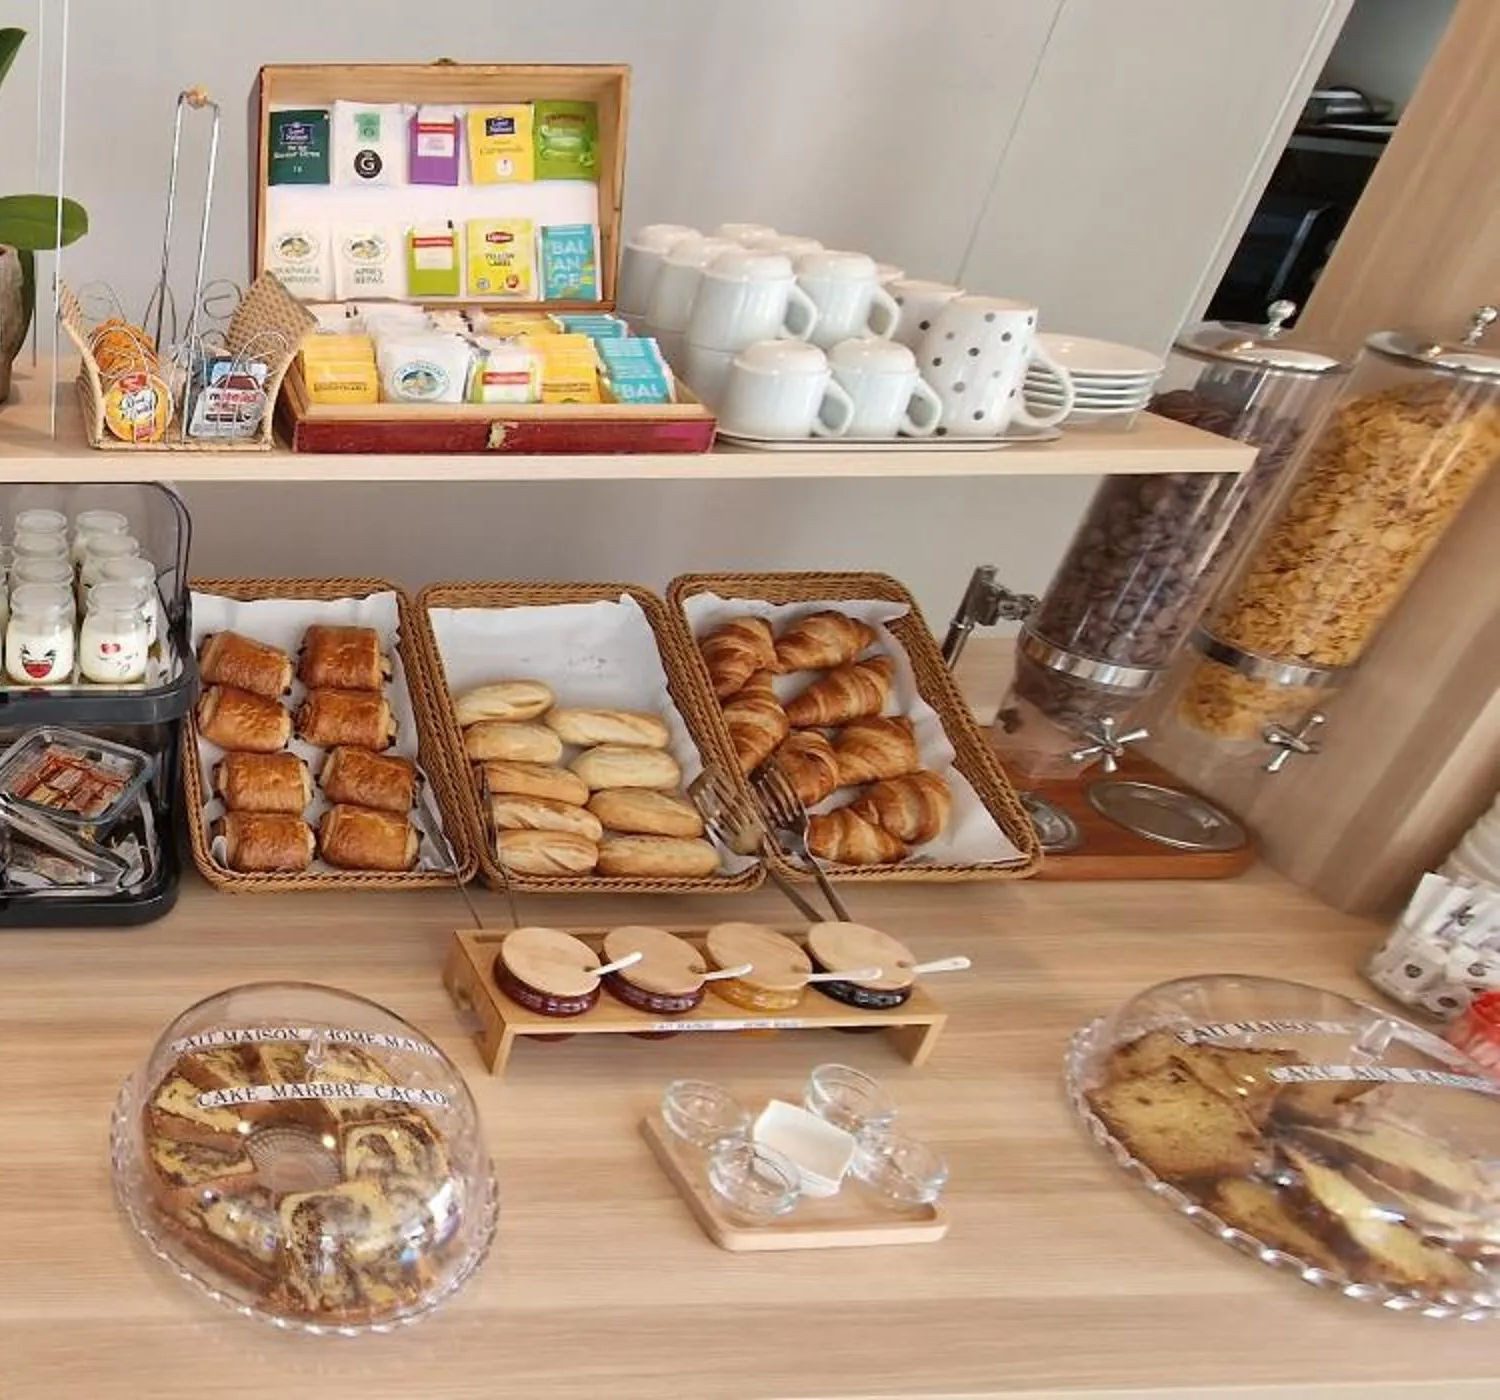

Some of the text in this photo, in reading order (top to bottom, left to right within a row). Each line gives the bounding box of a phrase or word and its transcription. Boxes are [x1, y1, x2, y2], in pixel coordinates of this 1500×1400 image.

[222, 1029, 300, 1042] MAISON
[326, 1028, 380, 1044] HOME
[196, 1082, 451, 1107] CAKE MARBRE CACAO
